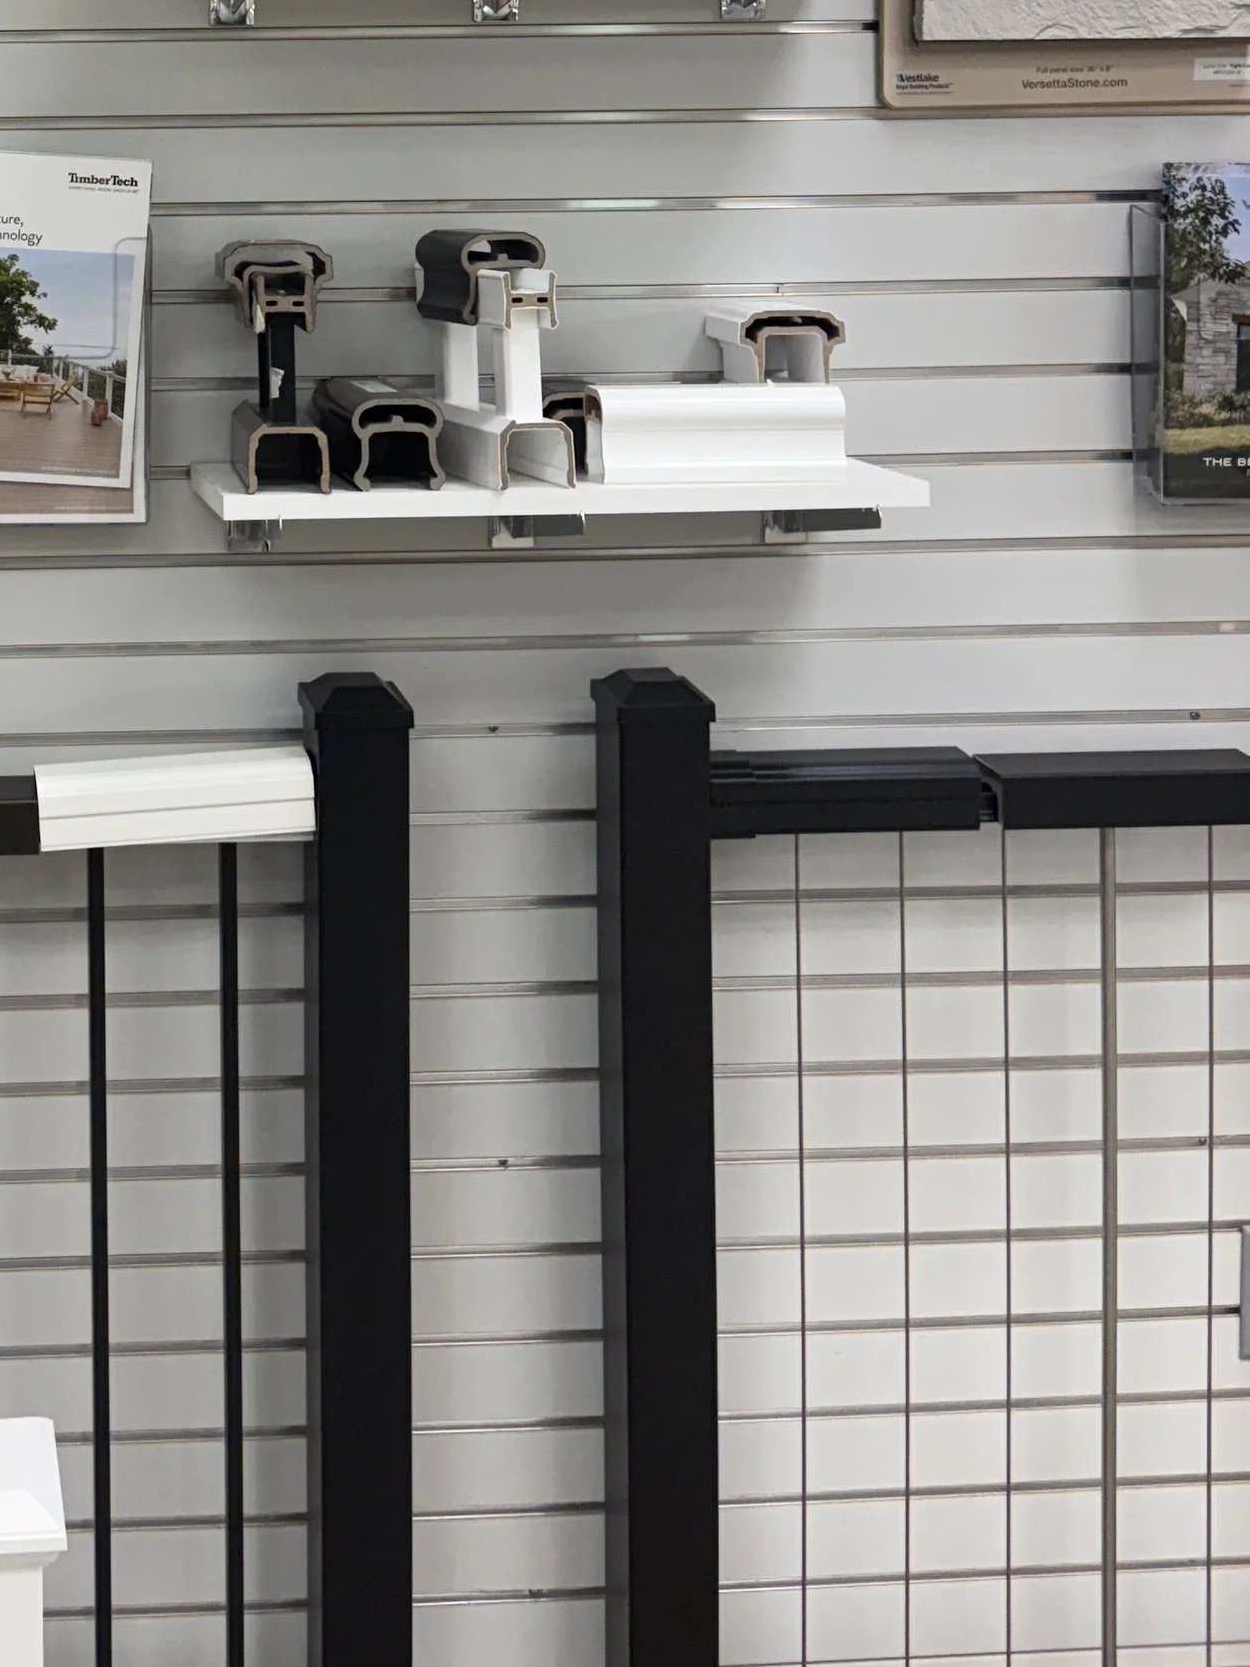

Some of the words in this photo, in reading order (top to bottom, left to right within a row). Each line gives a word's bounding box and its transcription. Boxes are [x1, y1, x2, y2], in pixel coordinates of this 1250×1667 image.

[1022, 77, 1128, 89] VersettaStone.com
[68, 172, 139, 188] TimberTech
[1203, 457, 1232, 467] THE
